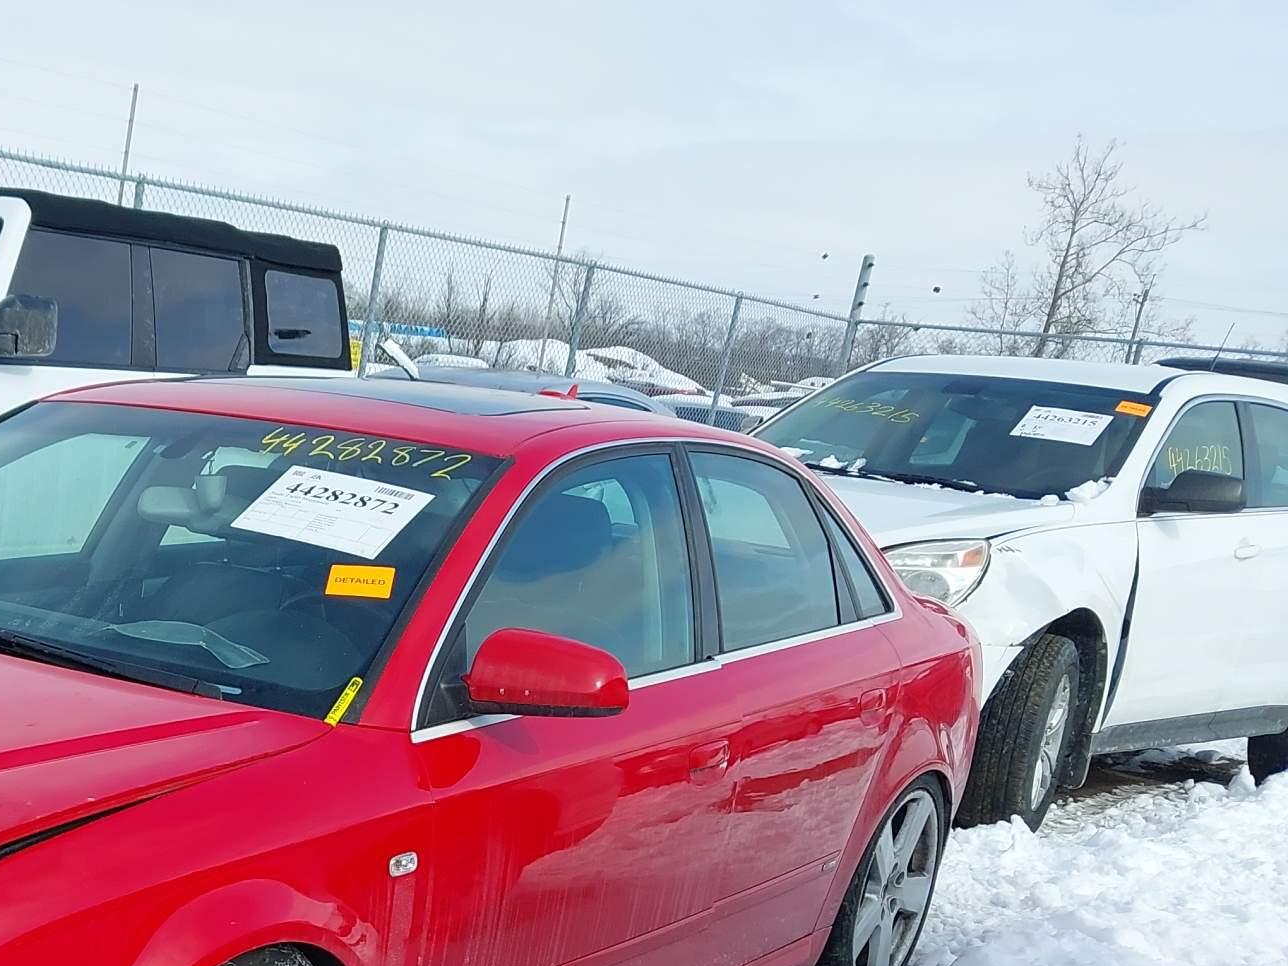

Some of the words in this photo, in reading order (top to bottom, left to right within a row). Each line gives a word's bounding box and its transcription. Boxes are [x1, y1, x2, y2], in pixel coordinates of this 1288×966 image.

[262, 427, 472, 481] 44282872
[285, 482, 400, 515] 44282872
[334, 576, 386, 586] DETAILED
